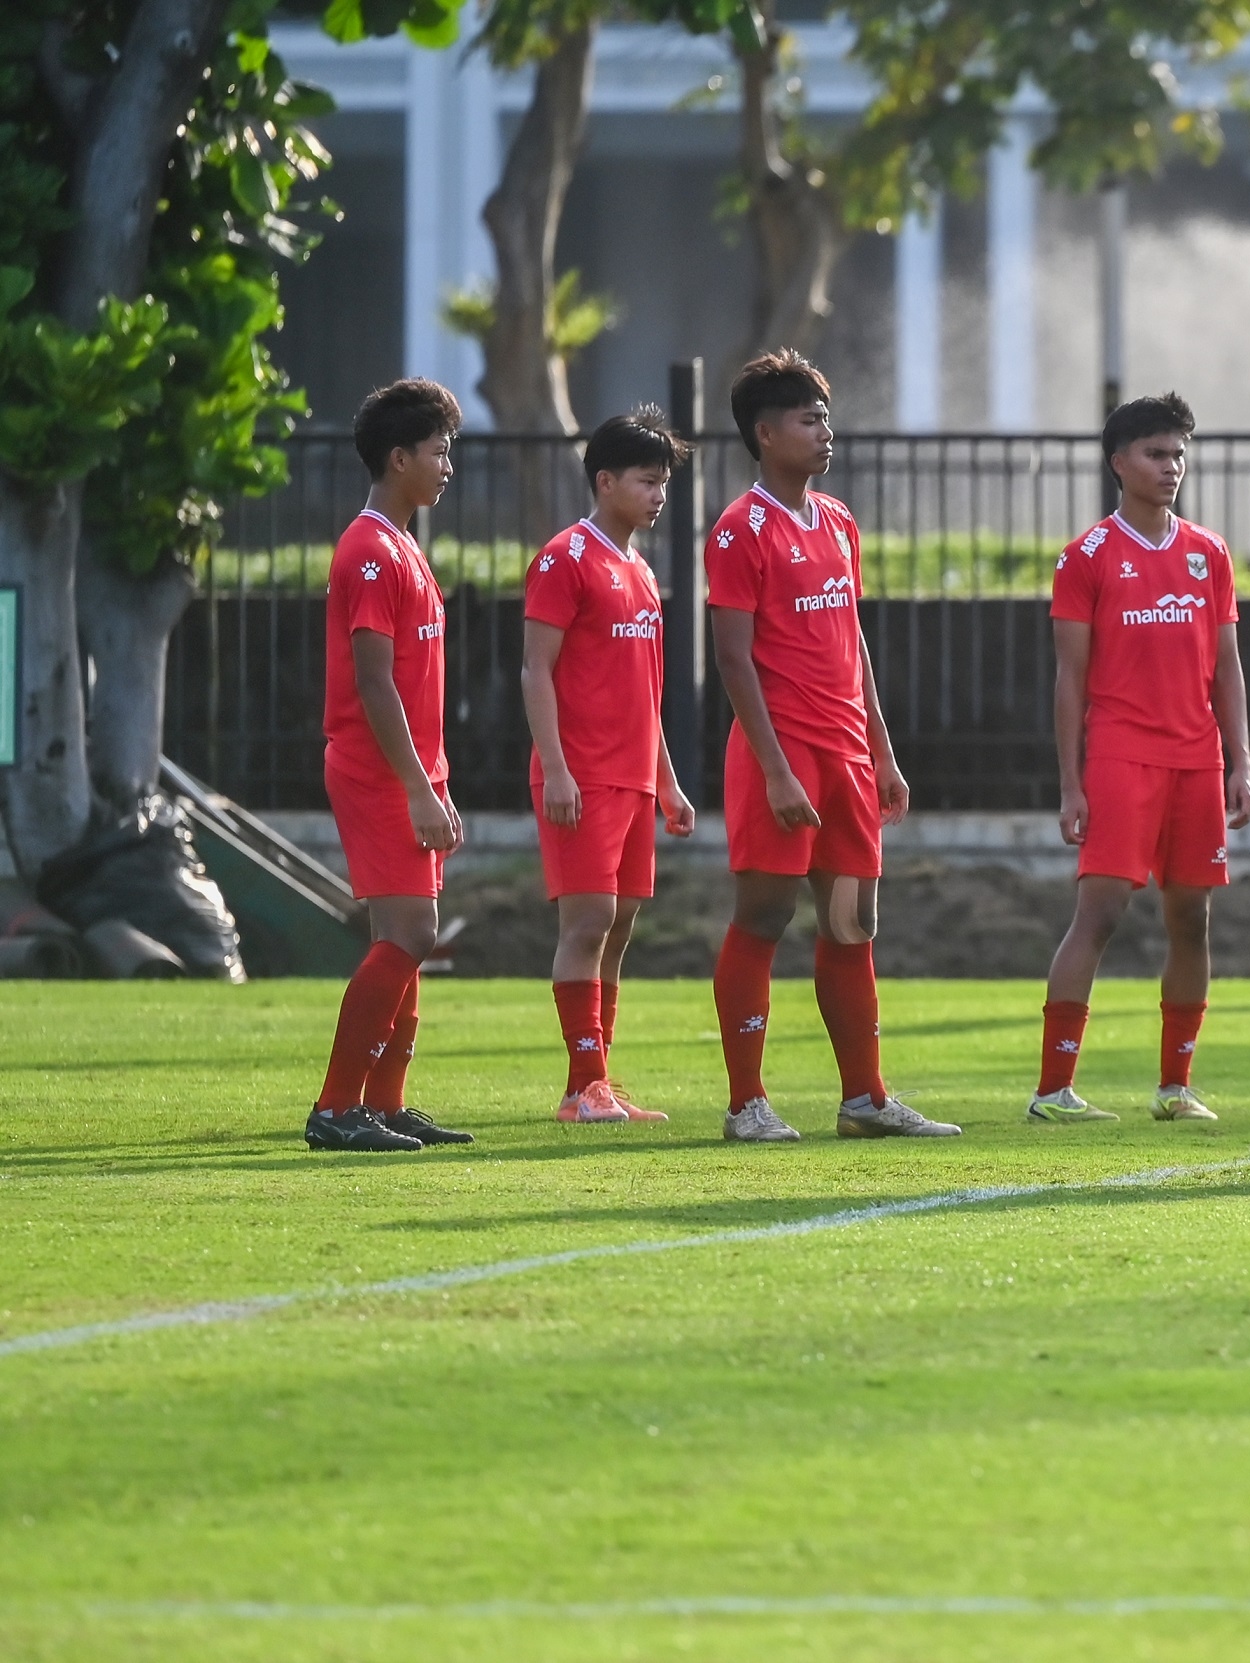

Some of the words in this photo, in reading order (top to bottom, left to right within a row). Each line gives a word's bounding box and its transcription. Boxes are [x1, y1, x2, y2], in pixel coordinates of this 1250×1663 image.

[748, 503, 767, 537] AQUA
[1080, 525, 1110, 559] AQUA
[795, 588, 849, 613] mandiri
[1121, 604, 1193, 626] mandiri
